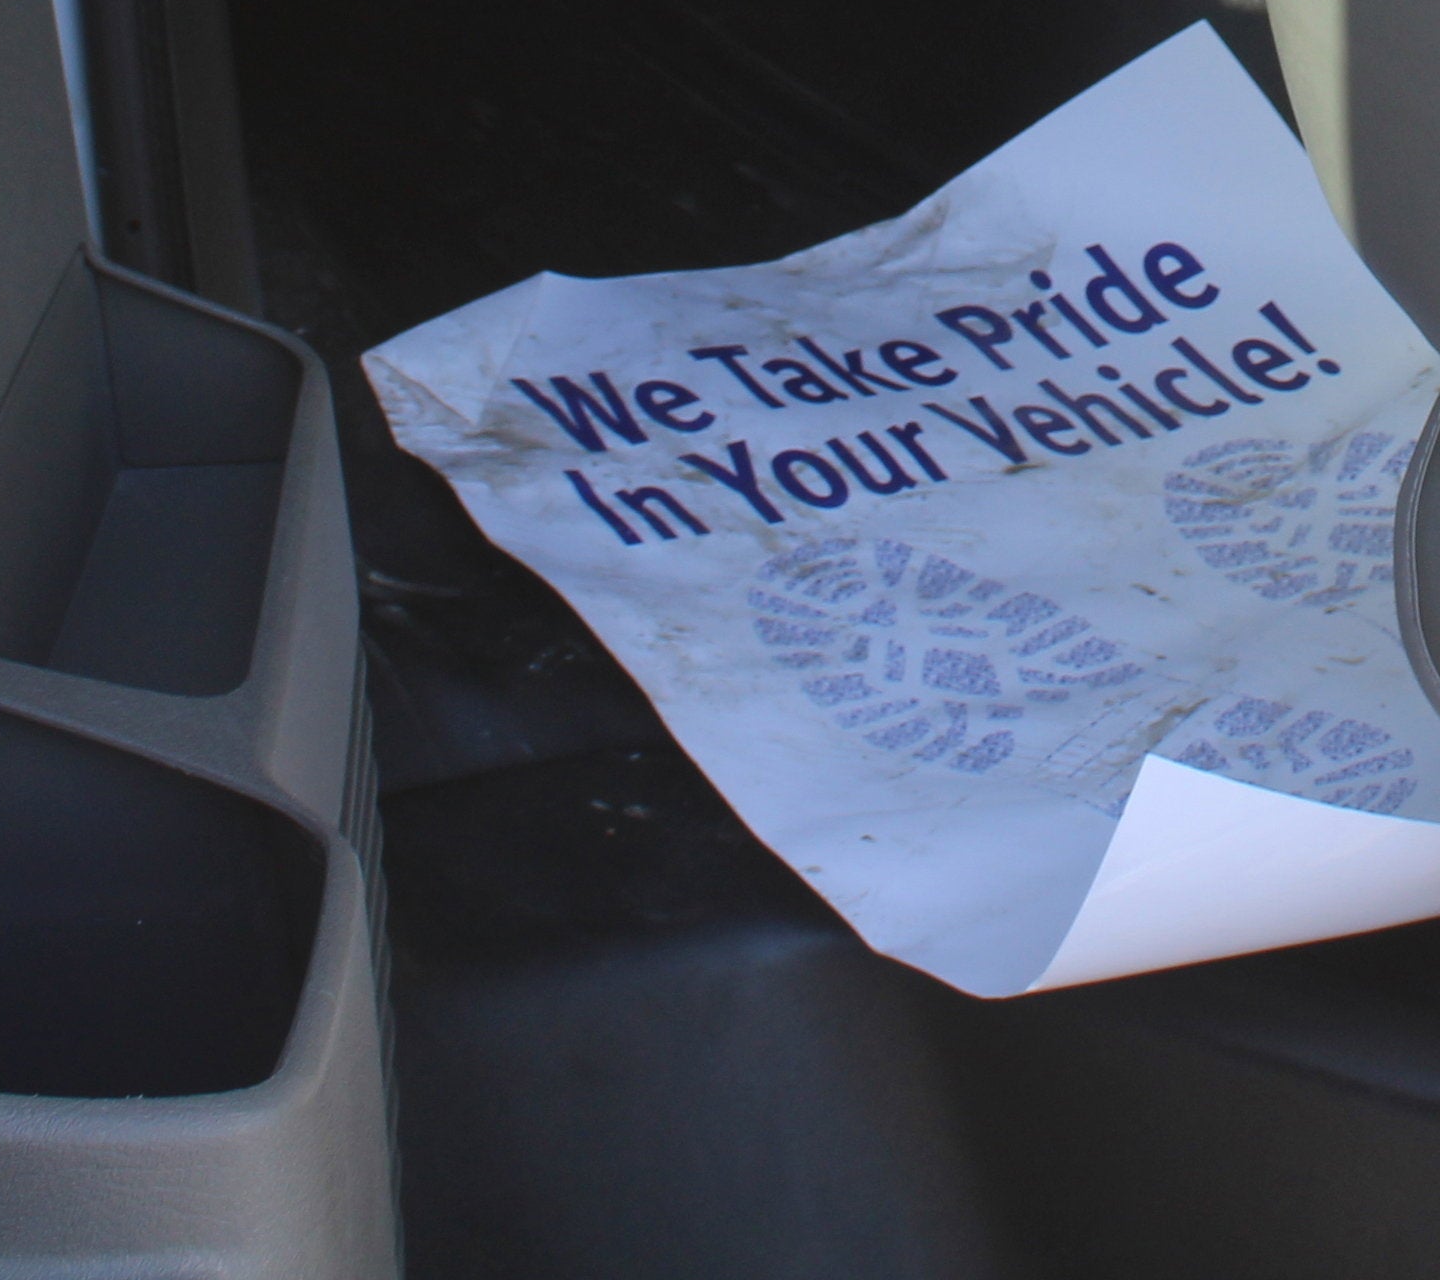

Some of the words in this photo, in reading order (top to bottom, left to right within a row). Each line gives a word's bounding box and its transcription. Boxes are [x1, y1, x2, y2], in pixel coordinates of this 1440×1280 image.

[510, 371, 716, 453] We
[689, 335, 959, 411] Take
[937, 240, 1221, 371] Pride
[563, 469, 711, 546] In
[678, 417, 949, 524] Your
[923, 300, 1342, 466] Vehicle!
